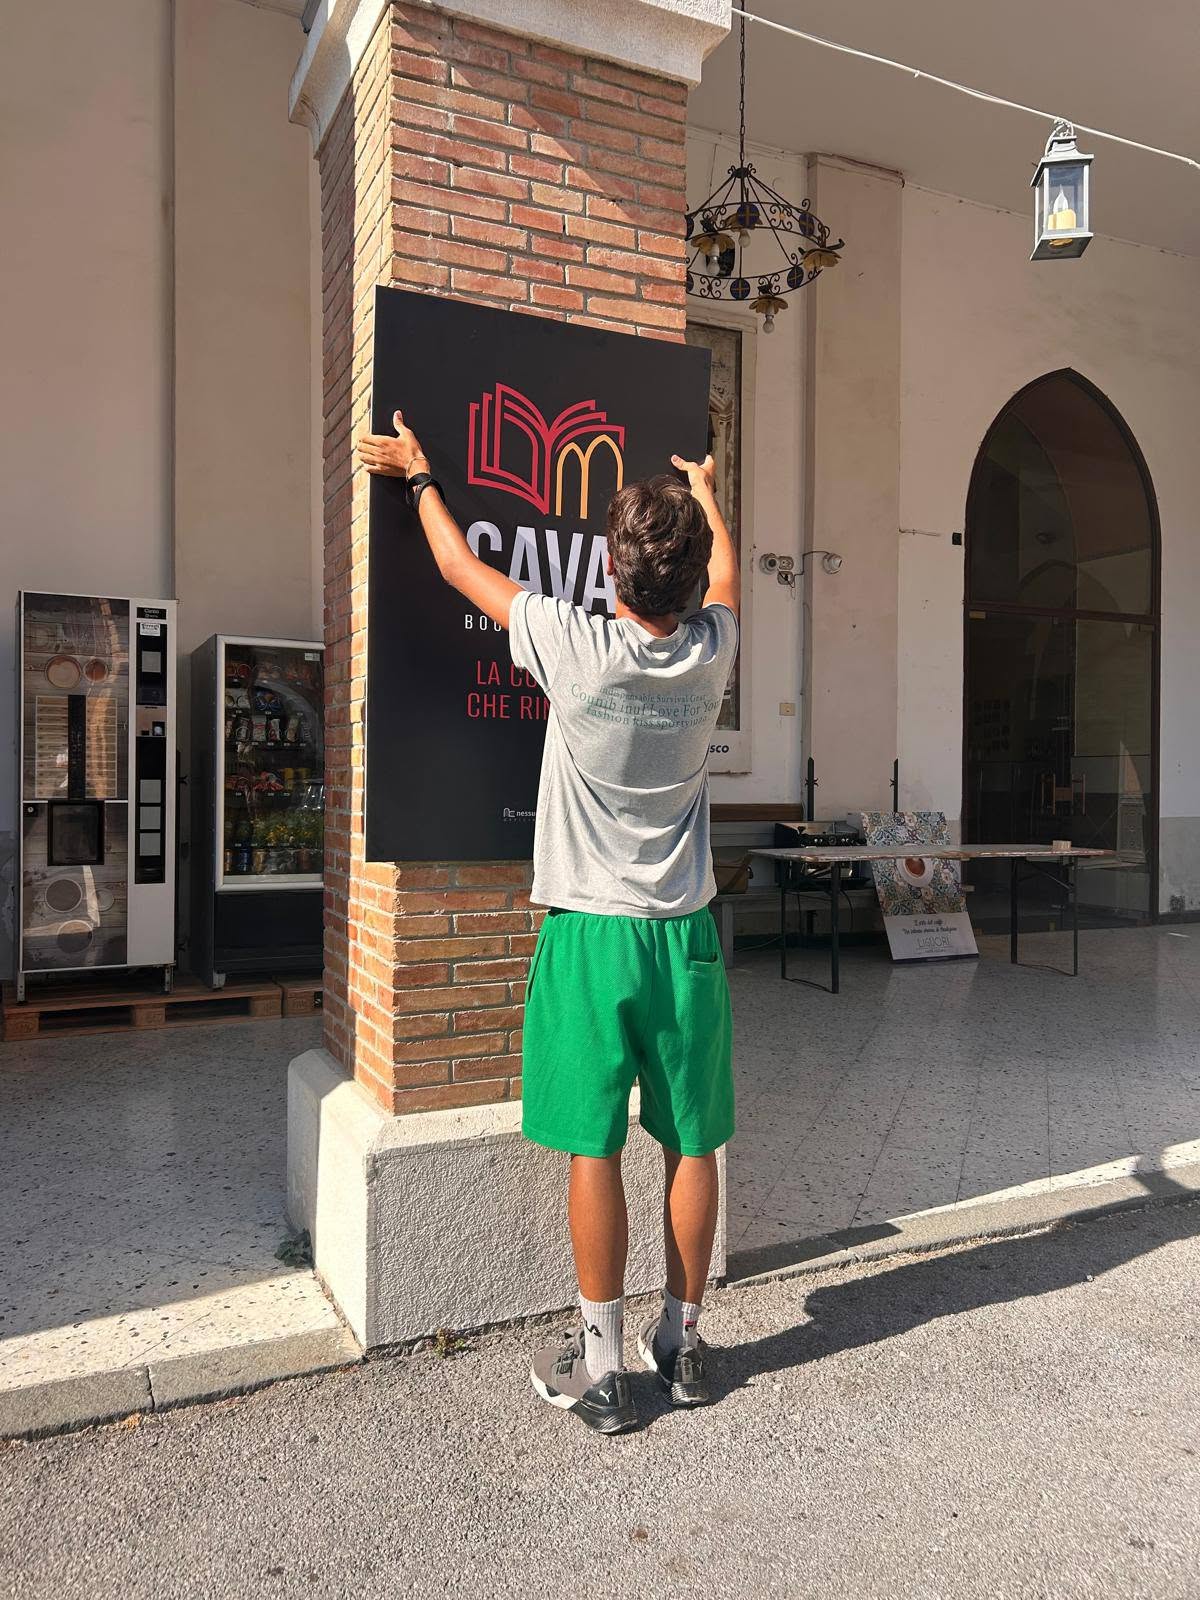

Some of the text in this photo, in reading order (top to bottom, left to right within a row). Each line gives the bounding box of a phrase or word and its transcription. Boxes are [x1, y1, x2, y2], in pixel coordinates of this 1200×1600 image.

[476, 660, 500, 685] LA
[467, 693, 511, 719] CHE
[586, 705, 630, 725] fashion
[650, 703, 680, 717] Love
[683, 704, 701, 717] For
